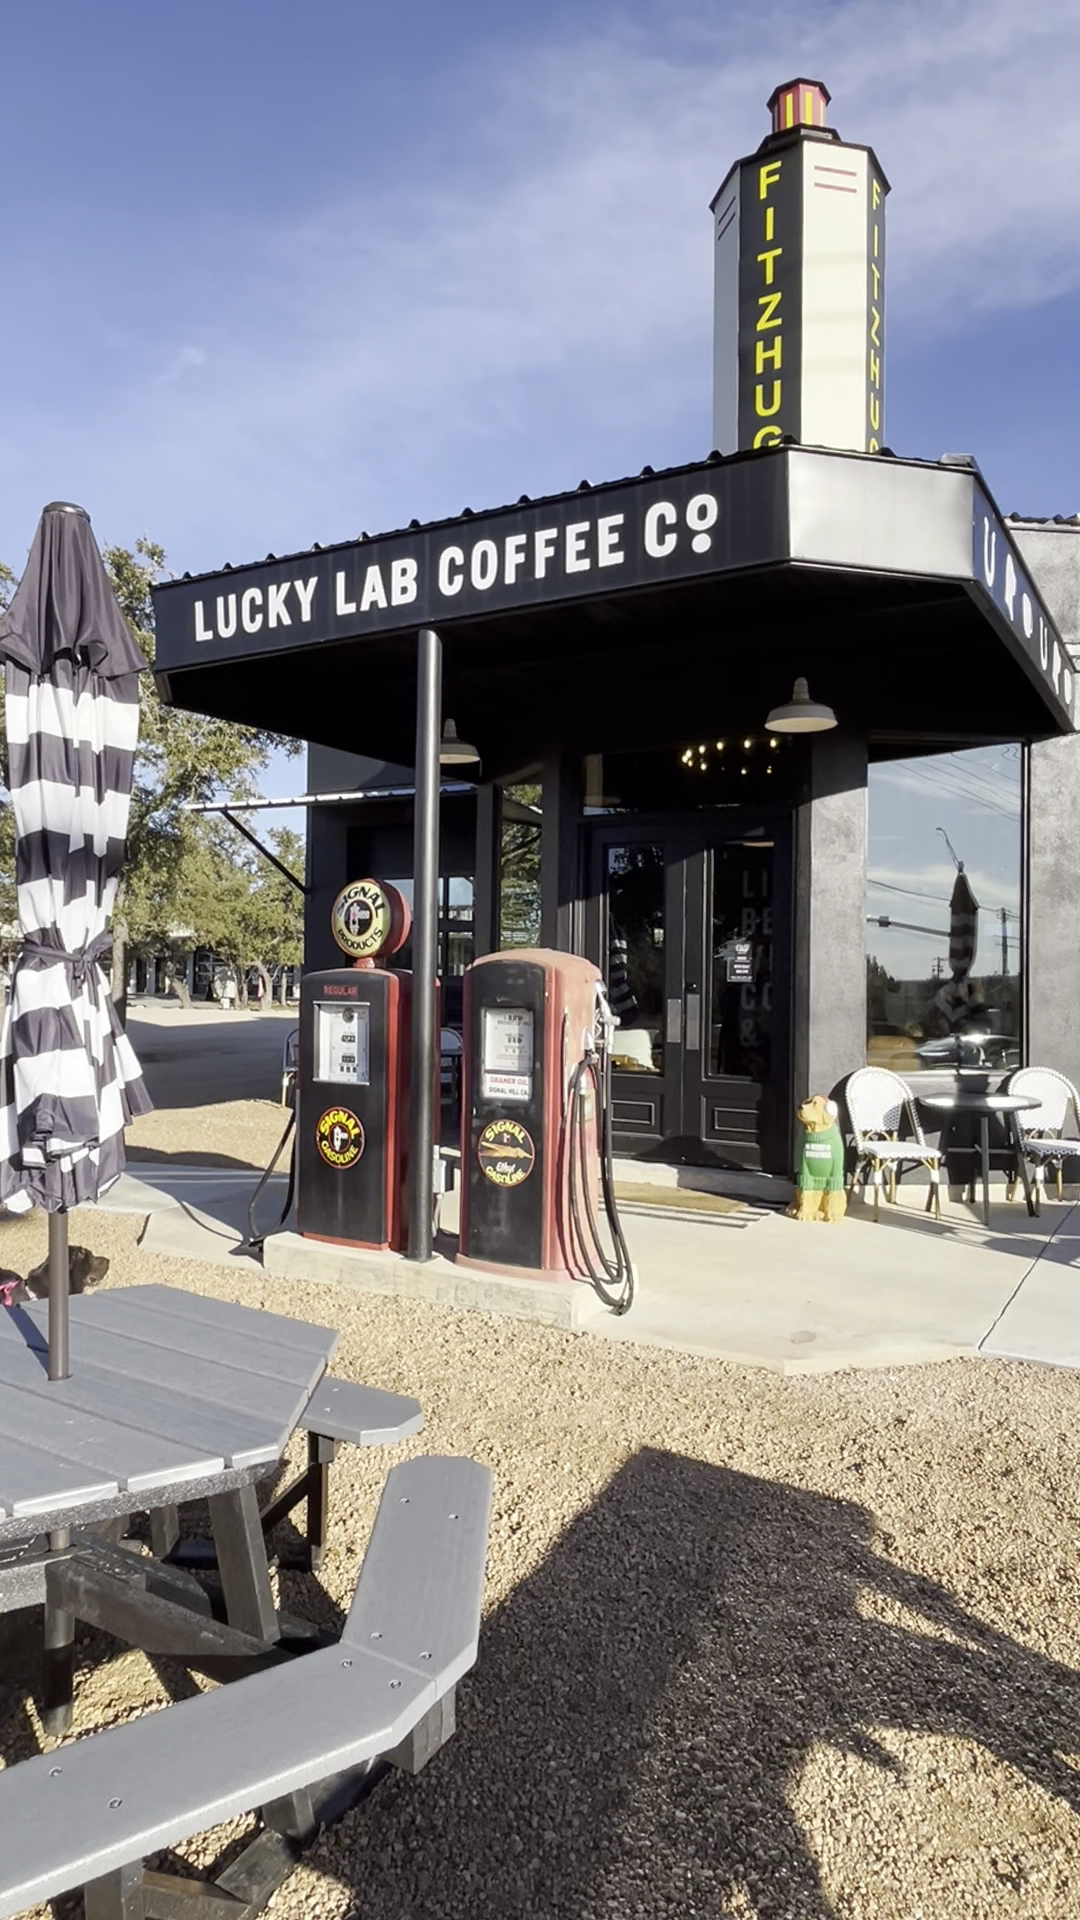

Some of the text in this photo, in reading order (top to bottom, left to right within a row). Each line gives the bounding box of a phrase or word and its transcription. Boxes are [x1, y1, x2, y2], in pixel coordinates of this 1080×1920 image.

[194, 577, 319, 643] LUCKY
[336, 558, 418, 616] LAB
[438, 513, 625, 596] COFFEE
[337, 886, 385, 918] SIGNAL
[338, 928, 383, 951] PRODUCTS
[323, 984, 358, 997] REGULAR
[320, 1110, 360, 1139] SIGNAL
[485, 1121, 525, 1144] SIGNAL
[321, 1140, 359, 1164] GASOLINE
[485, 1165, 526, 1185] GASOLINE
